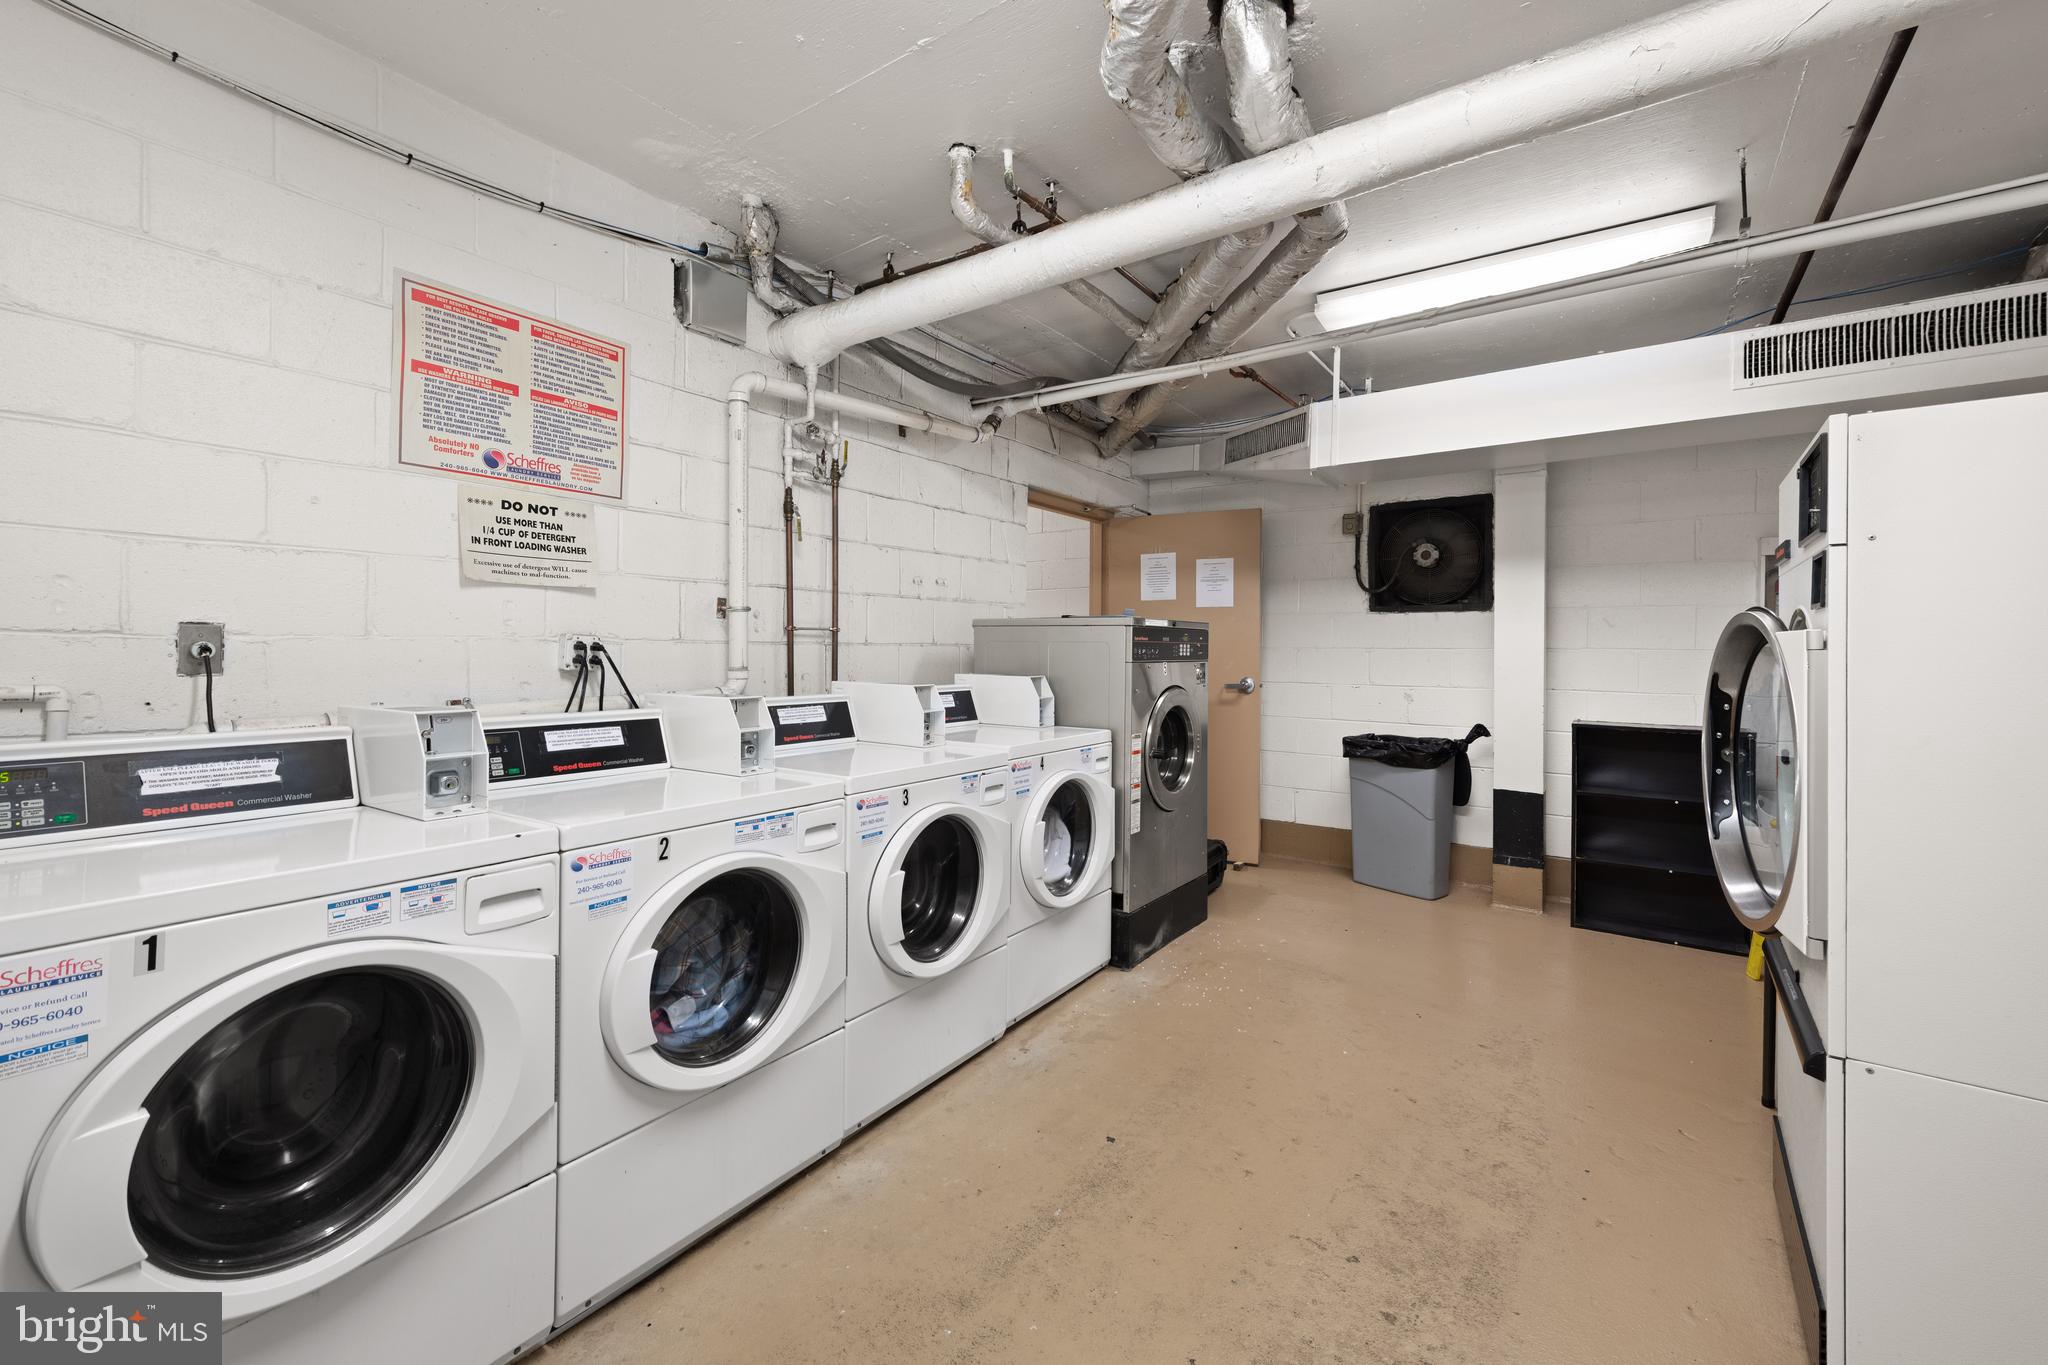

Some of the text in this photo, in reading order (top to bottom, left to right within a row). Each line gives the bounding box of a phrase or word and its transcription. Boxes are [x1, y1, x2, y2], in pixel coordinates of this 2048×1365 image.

[443, 367, 491, 384] WARNING
[563, 398, 588, 408] AVISO
[428, 435, 467, 449] Absolutely
[433, 444, 474, 457] Comforters
[440, 462, 487, 474] 240-965-6040
[507, 451, 561, 474] Scheffres
[507, 466, 533, 475] LAUNDRY
[502, 500, 558, 516] DO NOT
[496, 516, 563, 531] USE MORE THAN
[498, 528, 515, 537] CUP
[531, 532, 576, 543] DETERGENT
[484, 538, 512, 548] FRONT
[514, 542, 551, 552] LOADING
[554, 545, 586, 554] WASHER
[474, 559, 500, 568] Excessive
[554, 763, 577, 772] Speed
[1040, 756, 1044, 770] 4
[903, 789, 908, 806] 3
[143, 803, 188, 816] Speed
[191, 801, 234, 810] Queen
[237, 796, 283, 806] Commercial
[589, 848, 632, 864] Scheffres
[659, 837, 669, 860] 2
[578, 879, 622, 894] 240-965-6040
[336, 893, 384, 907] ADVERTENCIA
[142, 935, 158, 972] 1
[0, 958, 103, 990] Scheffres
[1, 972, 100, 996] LAUNDRY SERVICE
[0, 1006, 19, 1015] vice
[34, 996, 68, 1008] Refund
[71, 992, 88, 1000] Call
[8, 1038, 77, 1060] NOTICE
